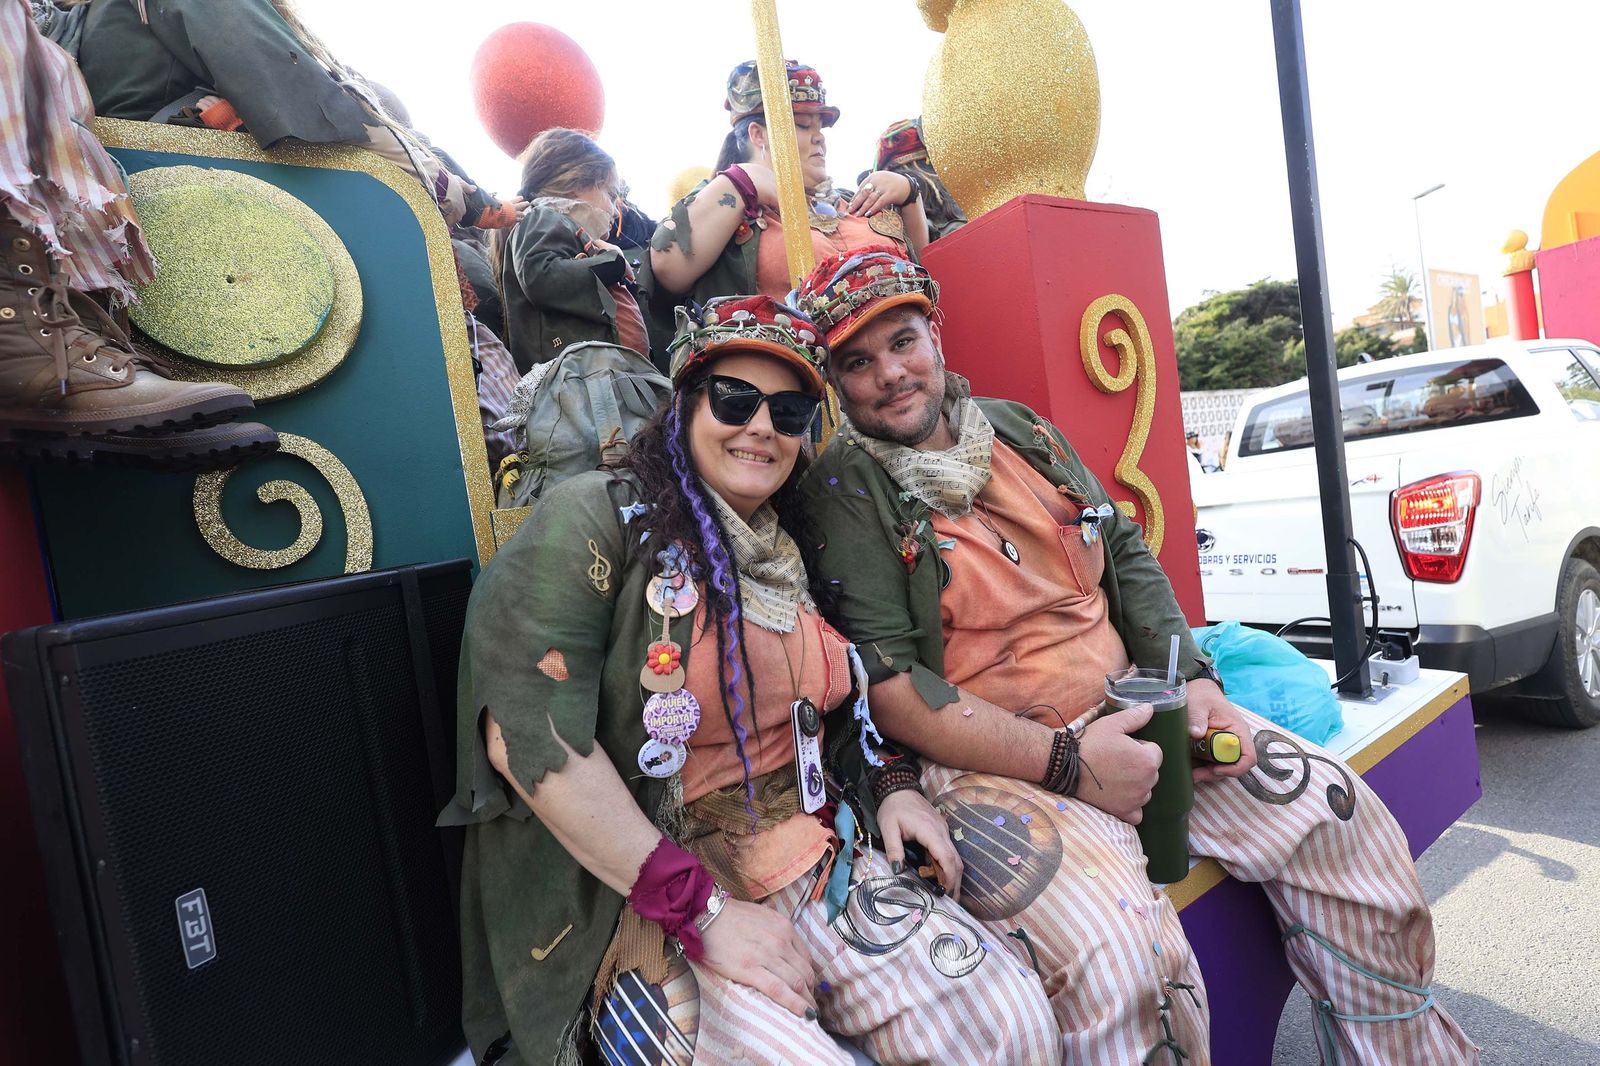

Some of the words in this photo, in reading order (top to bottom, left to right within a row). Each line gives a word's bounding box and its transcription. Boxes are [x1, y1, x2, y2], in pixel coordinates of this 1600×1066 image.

[1198, 554, 1223, 565] OBRAS
[1226, 554, 1231, 565] Y
[1233, 553, 1277, 565] SERVICIOS
[652, 699, 661, 711] A
[661, 696, 689, 710] QUIEN
[650, 711, 693, 727] IMPORTA!
[181, 896, 212, 954] FBT
